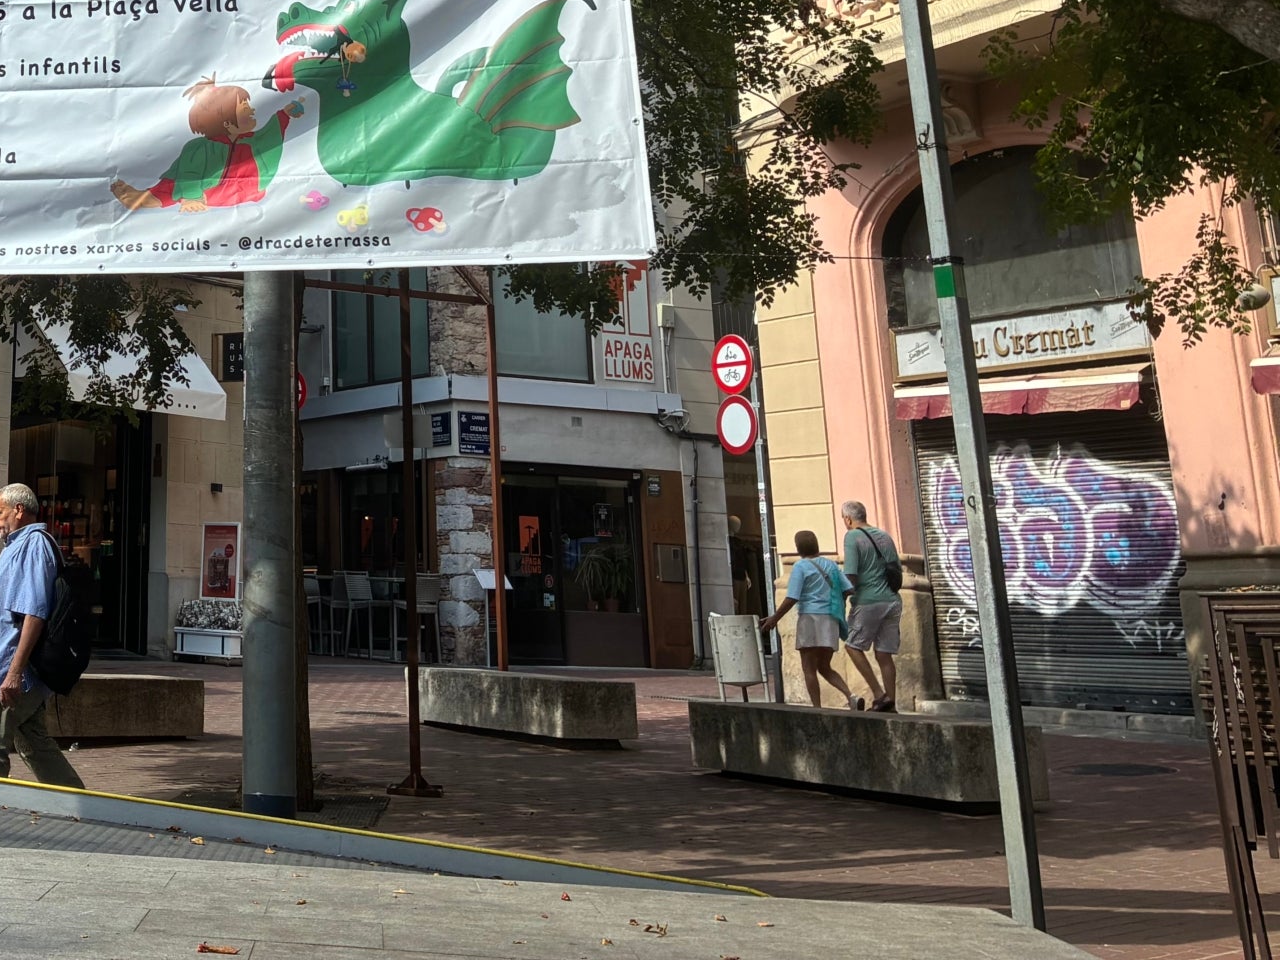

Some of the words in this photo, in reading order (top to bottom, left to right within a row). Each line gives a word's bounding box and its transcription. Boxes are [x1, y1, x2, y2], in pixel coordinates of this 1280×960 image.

[22, 6, 35, 20] a
[51, 0, 72, 19] la
[20, 55, 121, 76] infantils
[15, 244, 77, 256] nostres
[86, 242, 143, 254] xarxes
[152, 239, 211, 252] socials
[238, 234, 392, 251] @dracdeterrassa
[604, 339, 652, 360] APAGA
[605, 359, 653, 381] LLUMS
